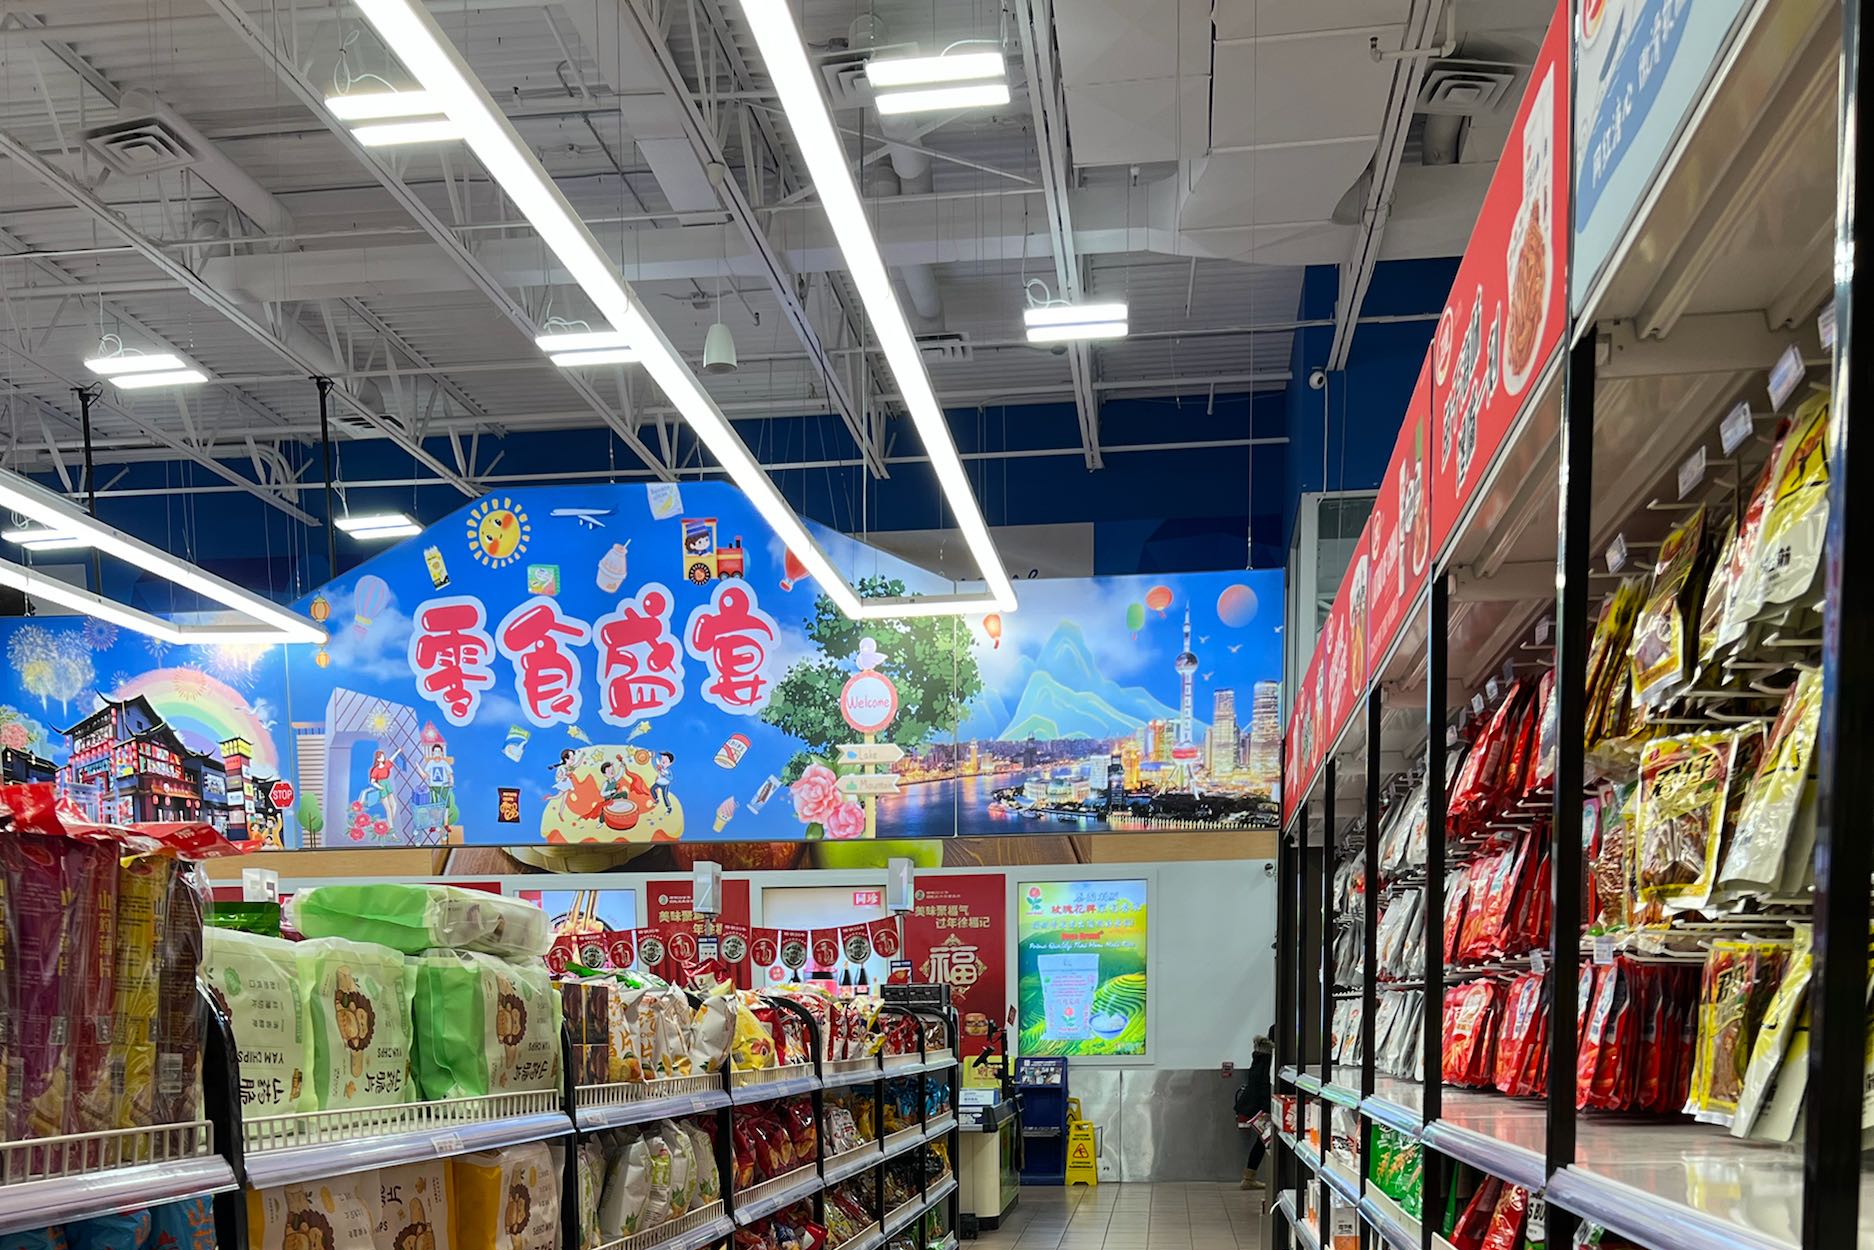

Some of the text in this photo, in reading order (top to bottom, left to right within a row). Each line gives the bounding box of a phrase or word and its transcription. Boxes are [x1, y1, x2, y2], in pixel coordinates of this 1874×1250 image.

[412, 585, 778, 721] 零食盛宴
[848, 695, 890, 709] Welcome
[860, 749, 877, 760] Lake
[432, 766, 443, 781] A
[272, 788, 294, 802] STOP
[928, 946, 979, 986] 福
[237, 1050, 285, 1065] YAM CHIPS
